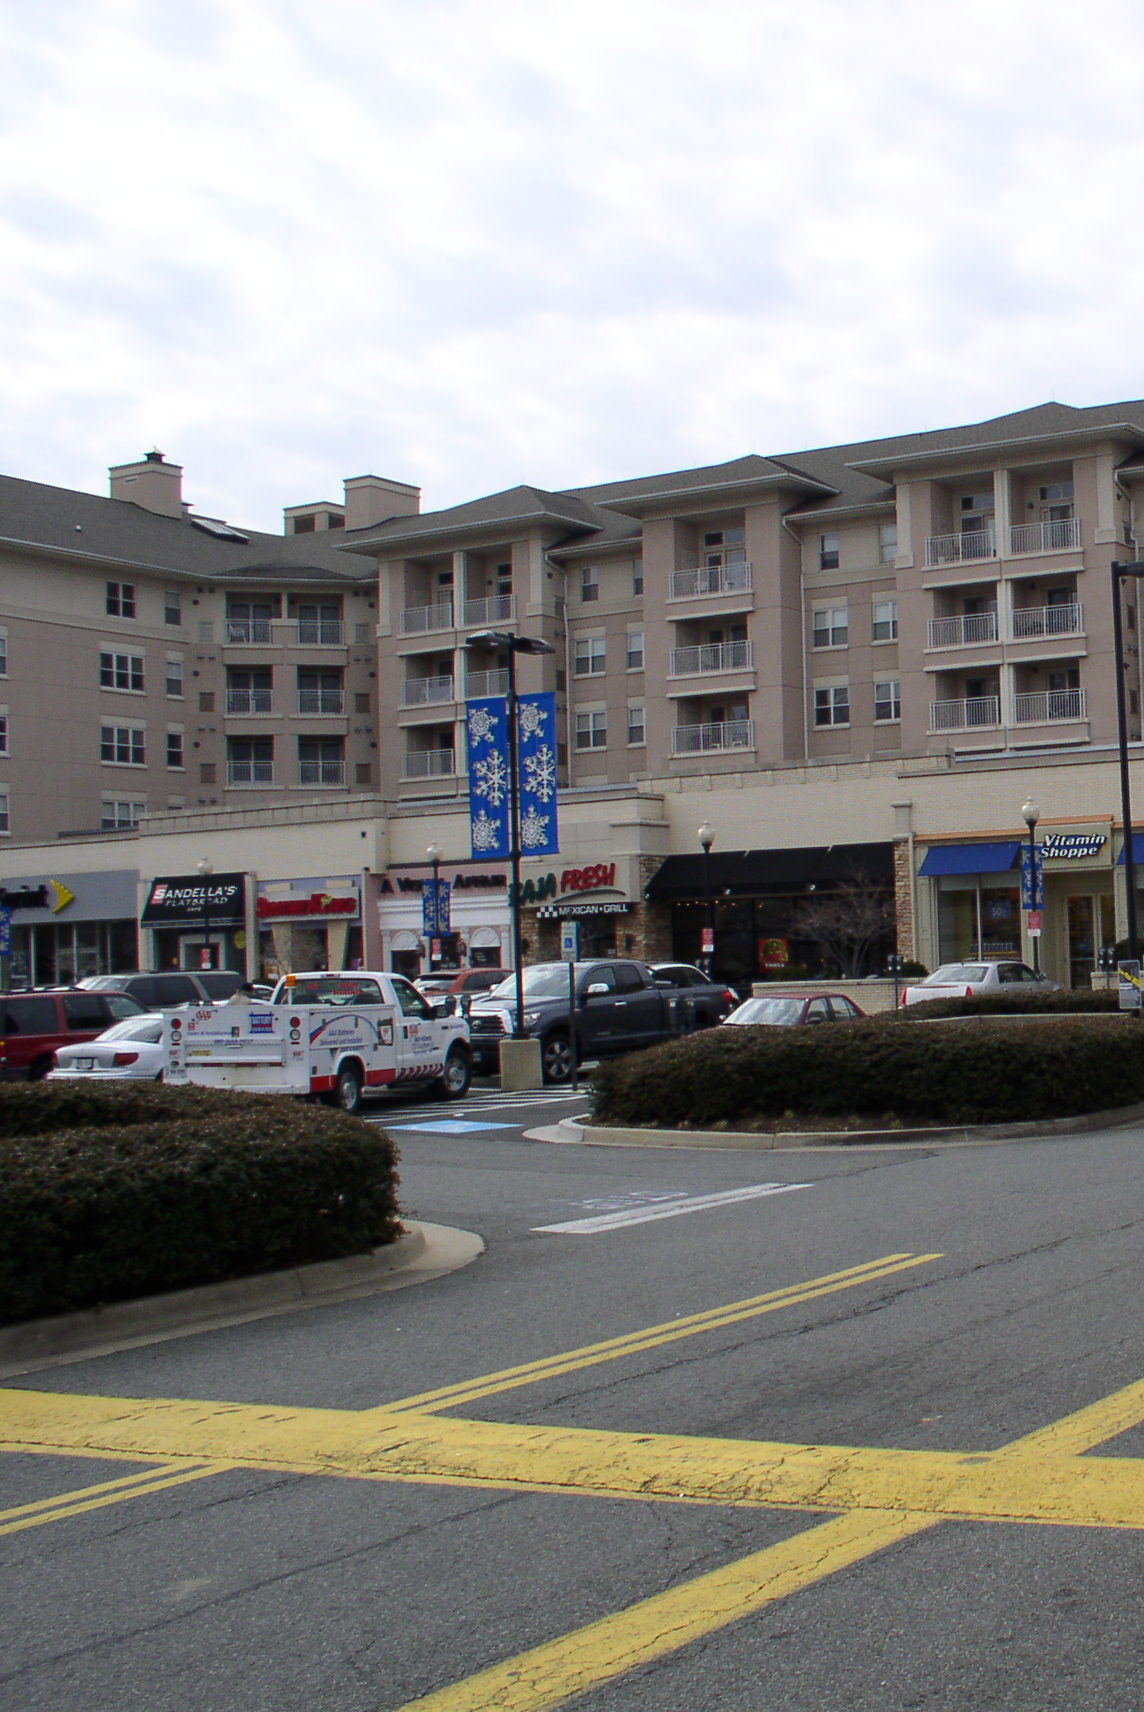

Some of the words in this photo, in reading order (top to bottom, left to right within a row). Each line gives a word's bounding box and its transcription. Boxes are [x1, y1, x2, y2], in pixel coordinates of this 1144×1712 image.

[1044, 833, 1106, 847] Vitamin
[1041, 846, 1098, 858] Shoppe
[561, 863, 615, 893] FRESH
[153, 885, 238, 899] SANDELLA'S
[165, 897, 228, 907] FLATBRAD
[559, 904, 599, 915] MEXICAN
[603, 903, 628, 913] GRILL
